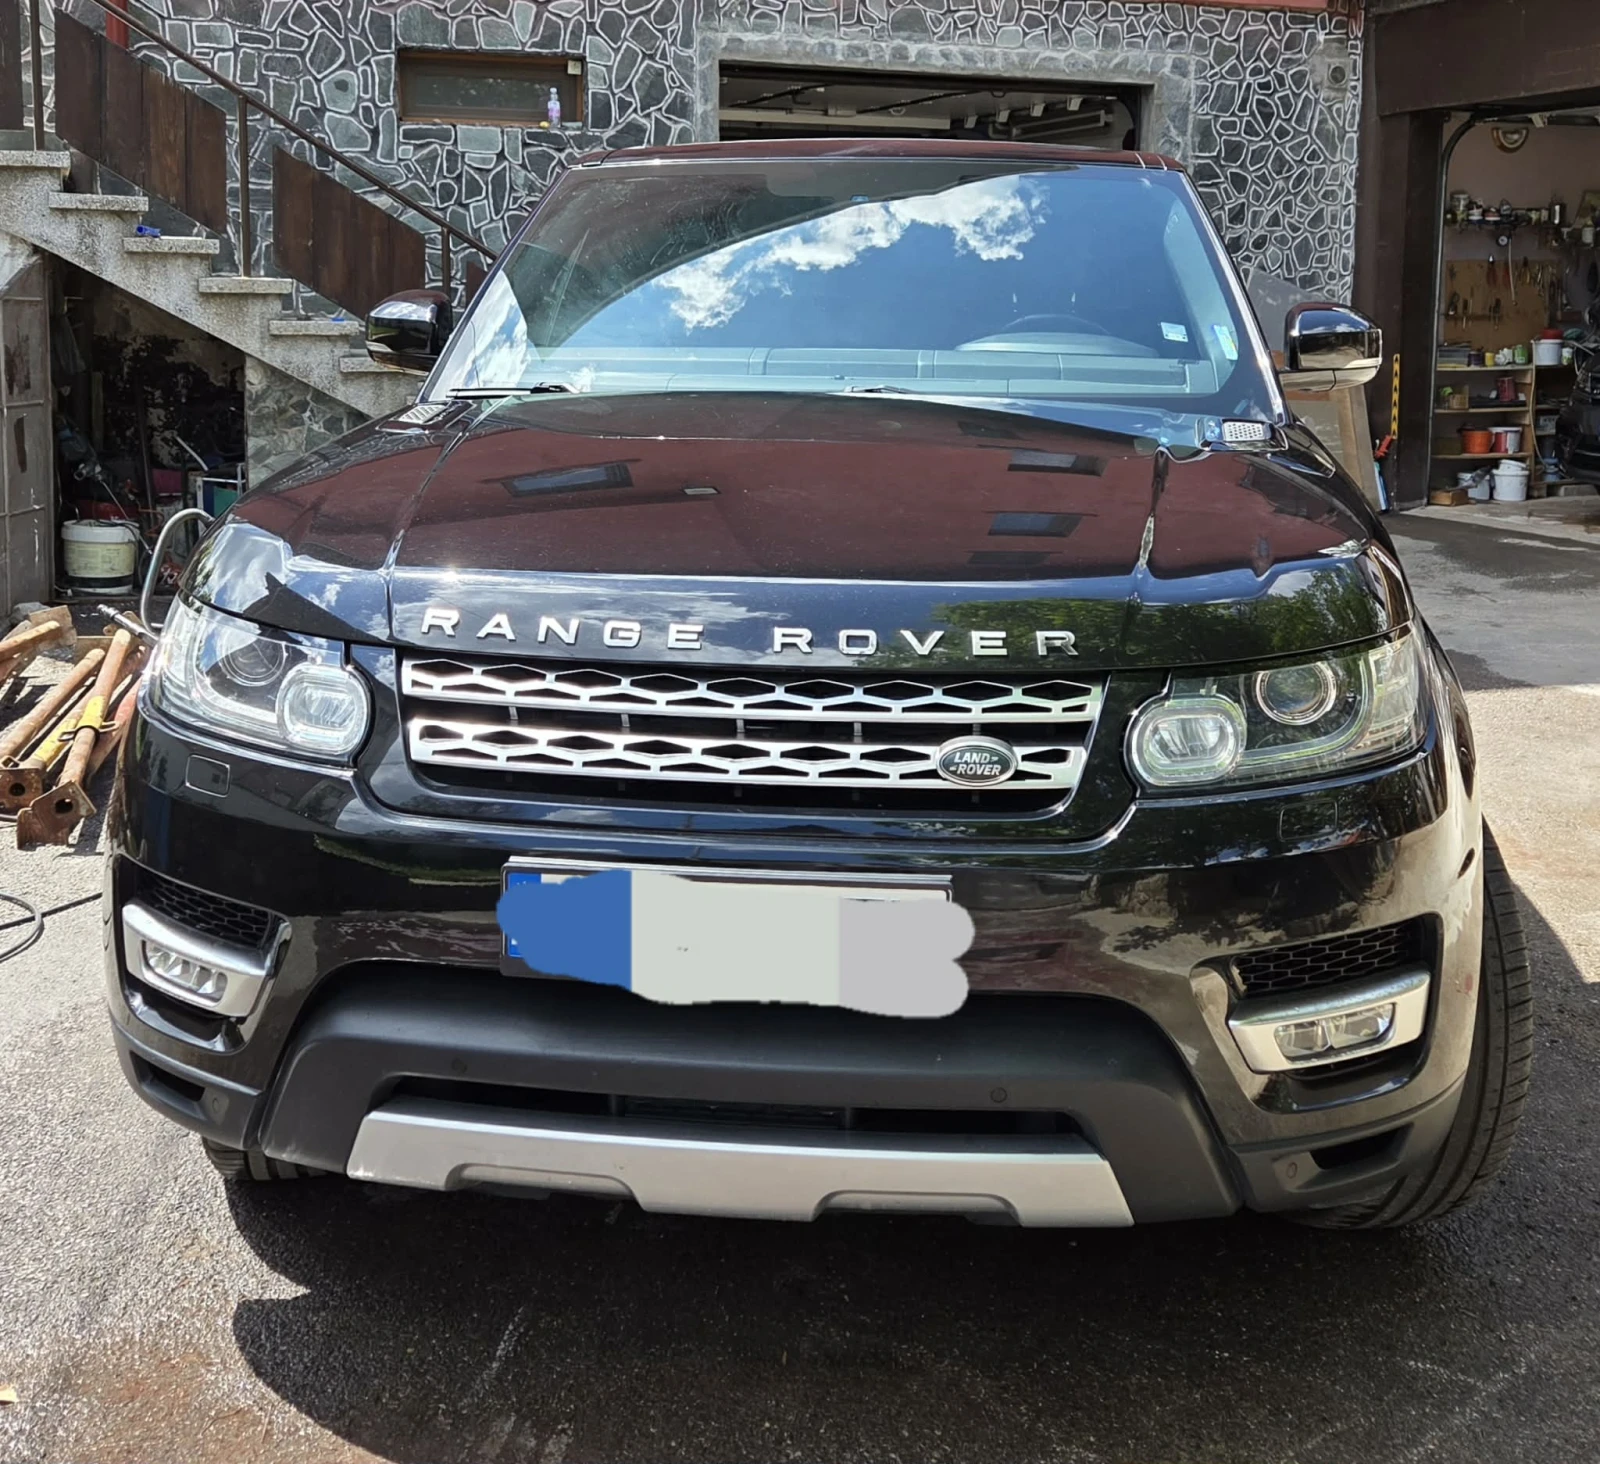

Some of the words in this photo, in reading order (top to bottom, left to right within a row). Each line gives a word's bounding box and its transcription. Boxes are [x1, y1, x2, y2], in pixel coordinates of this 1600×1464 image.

[420, 608, 703, 650] RANGE
[773, 626, 1080, 656] ROVER
[954, 752, 990, 764] LAND
[957, 764, 1002, 776] ROVER
